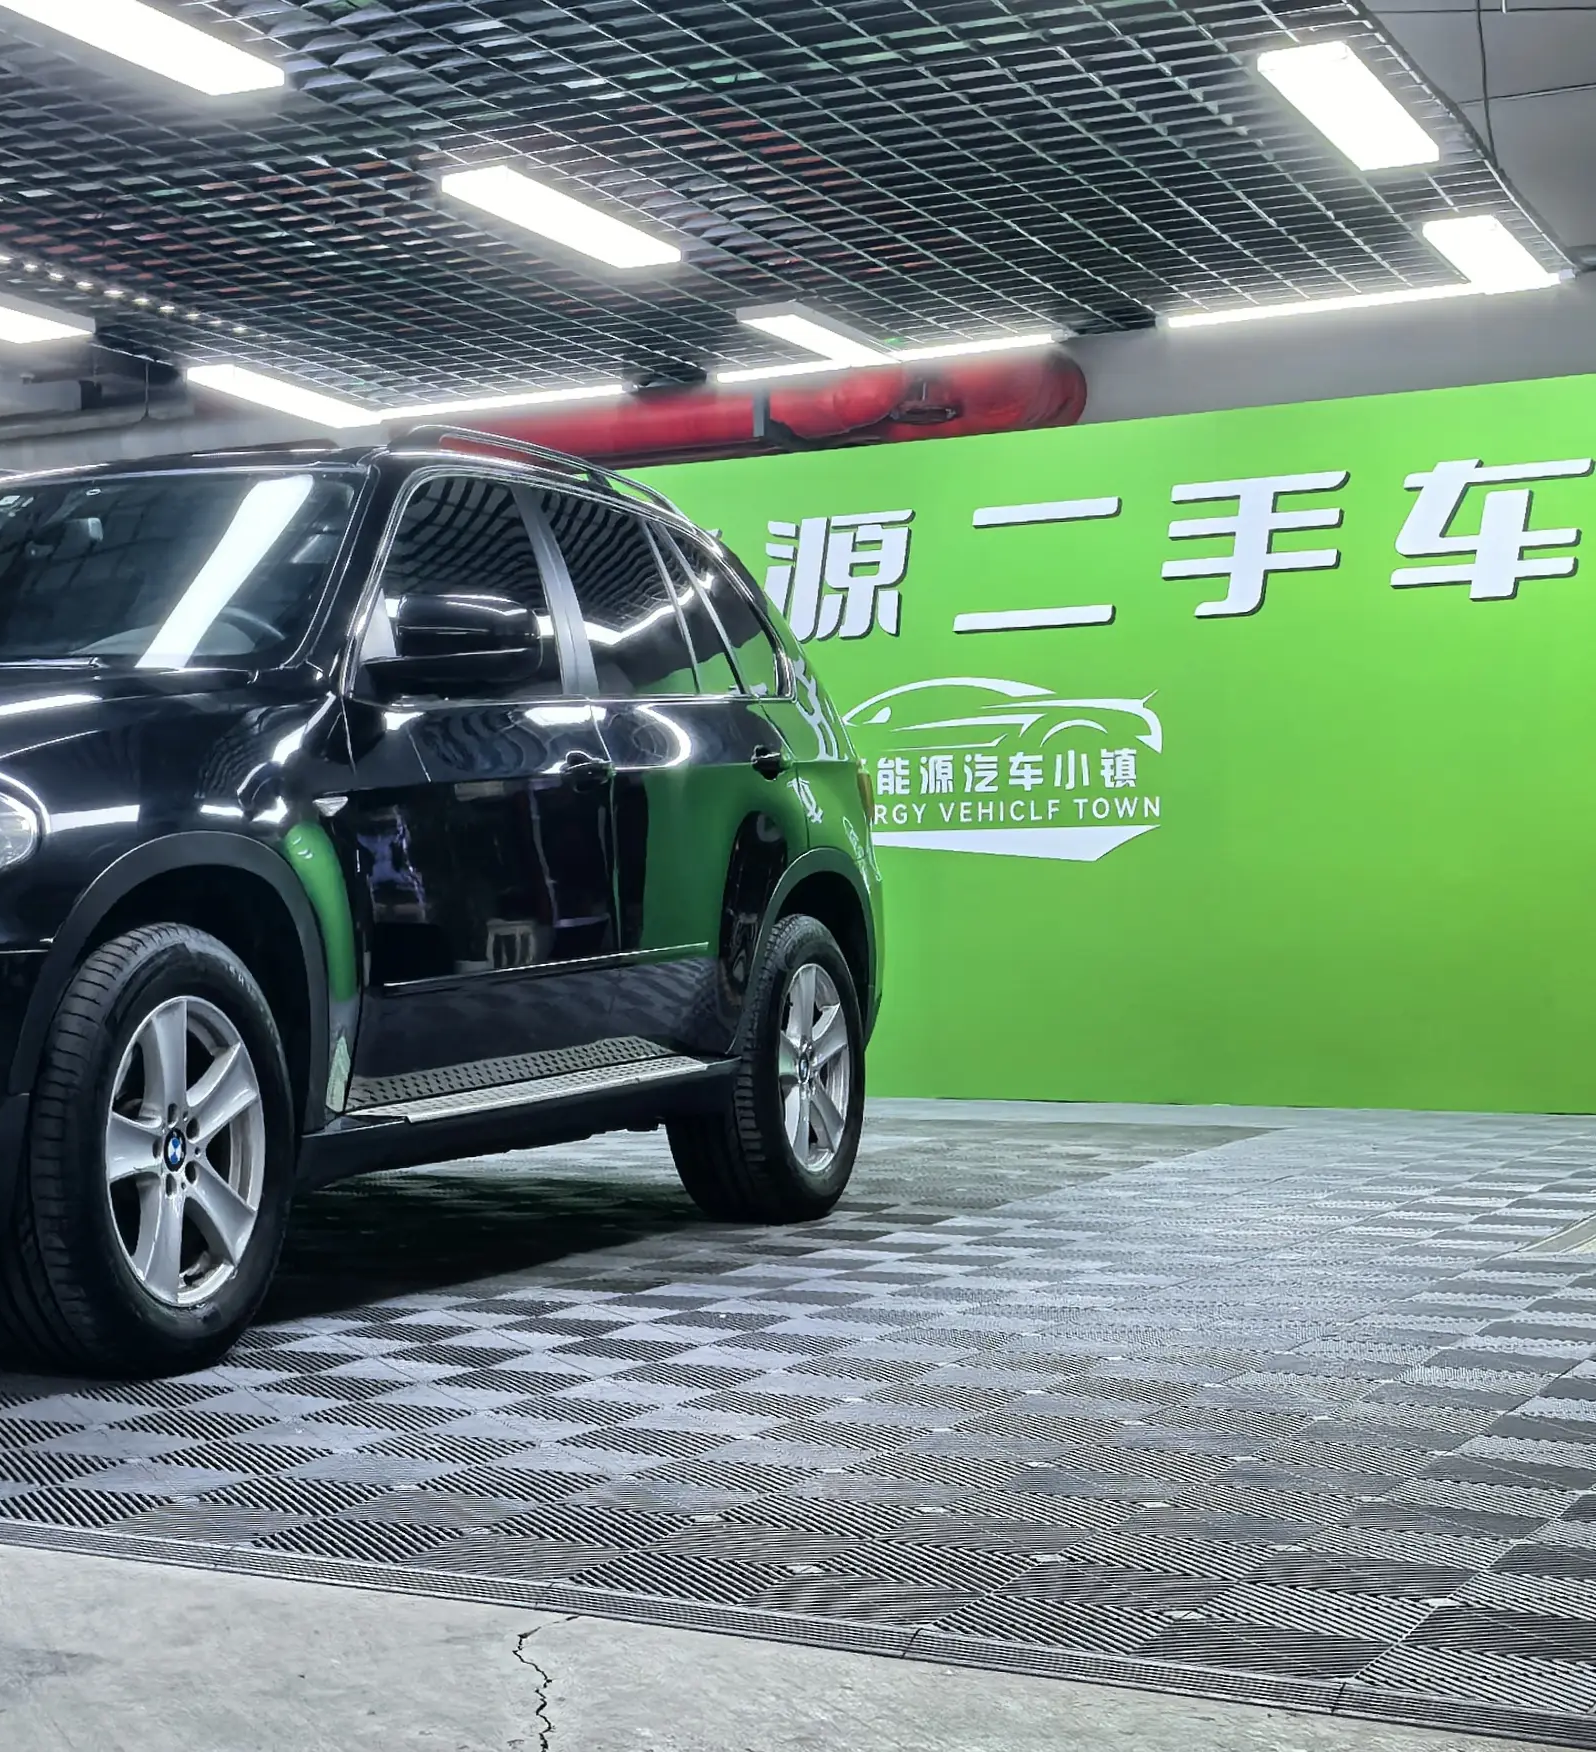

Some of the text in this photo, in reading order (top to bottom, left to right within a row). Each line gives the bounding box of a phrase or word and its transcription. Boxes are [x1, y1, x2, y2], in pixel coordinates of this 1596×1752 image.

[707, 458, 1594, 644] 源二手车
[860, 748, 1139, 796] 能源汽车小镇
[1074, 796, 1161, 819] TOWN
